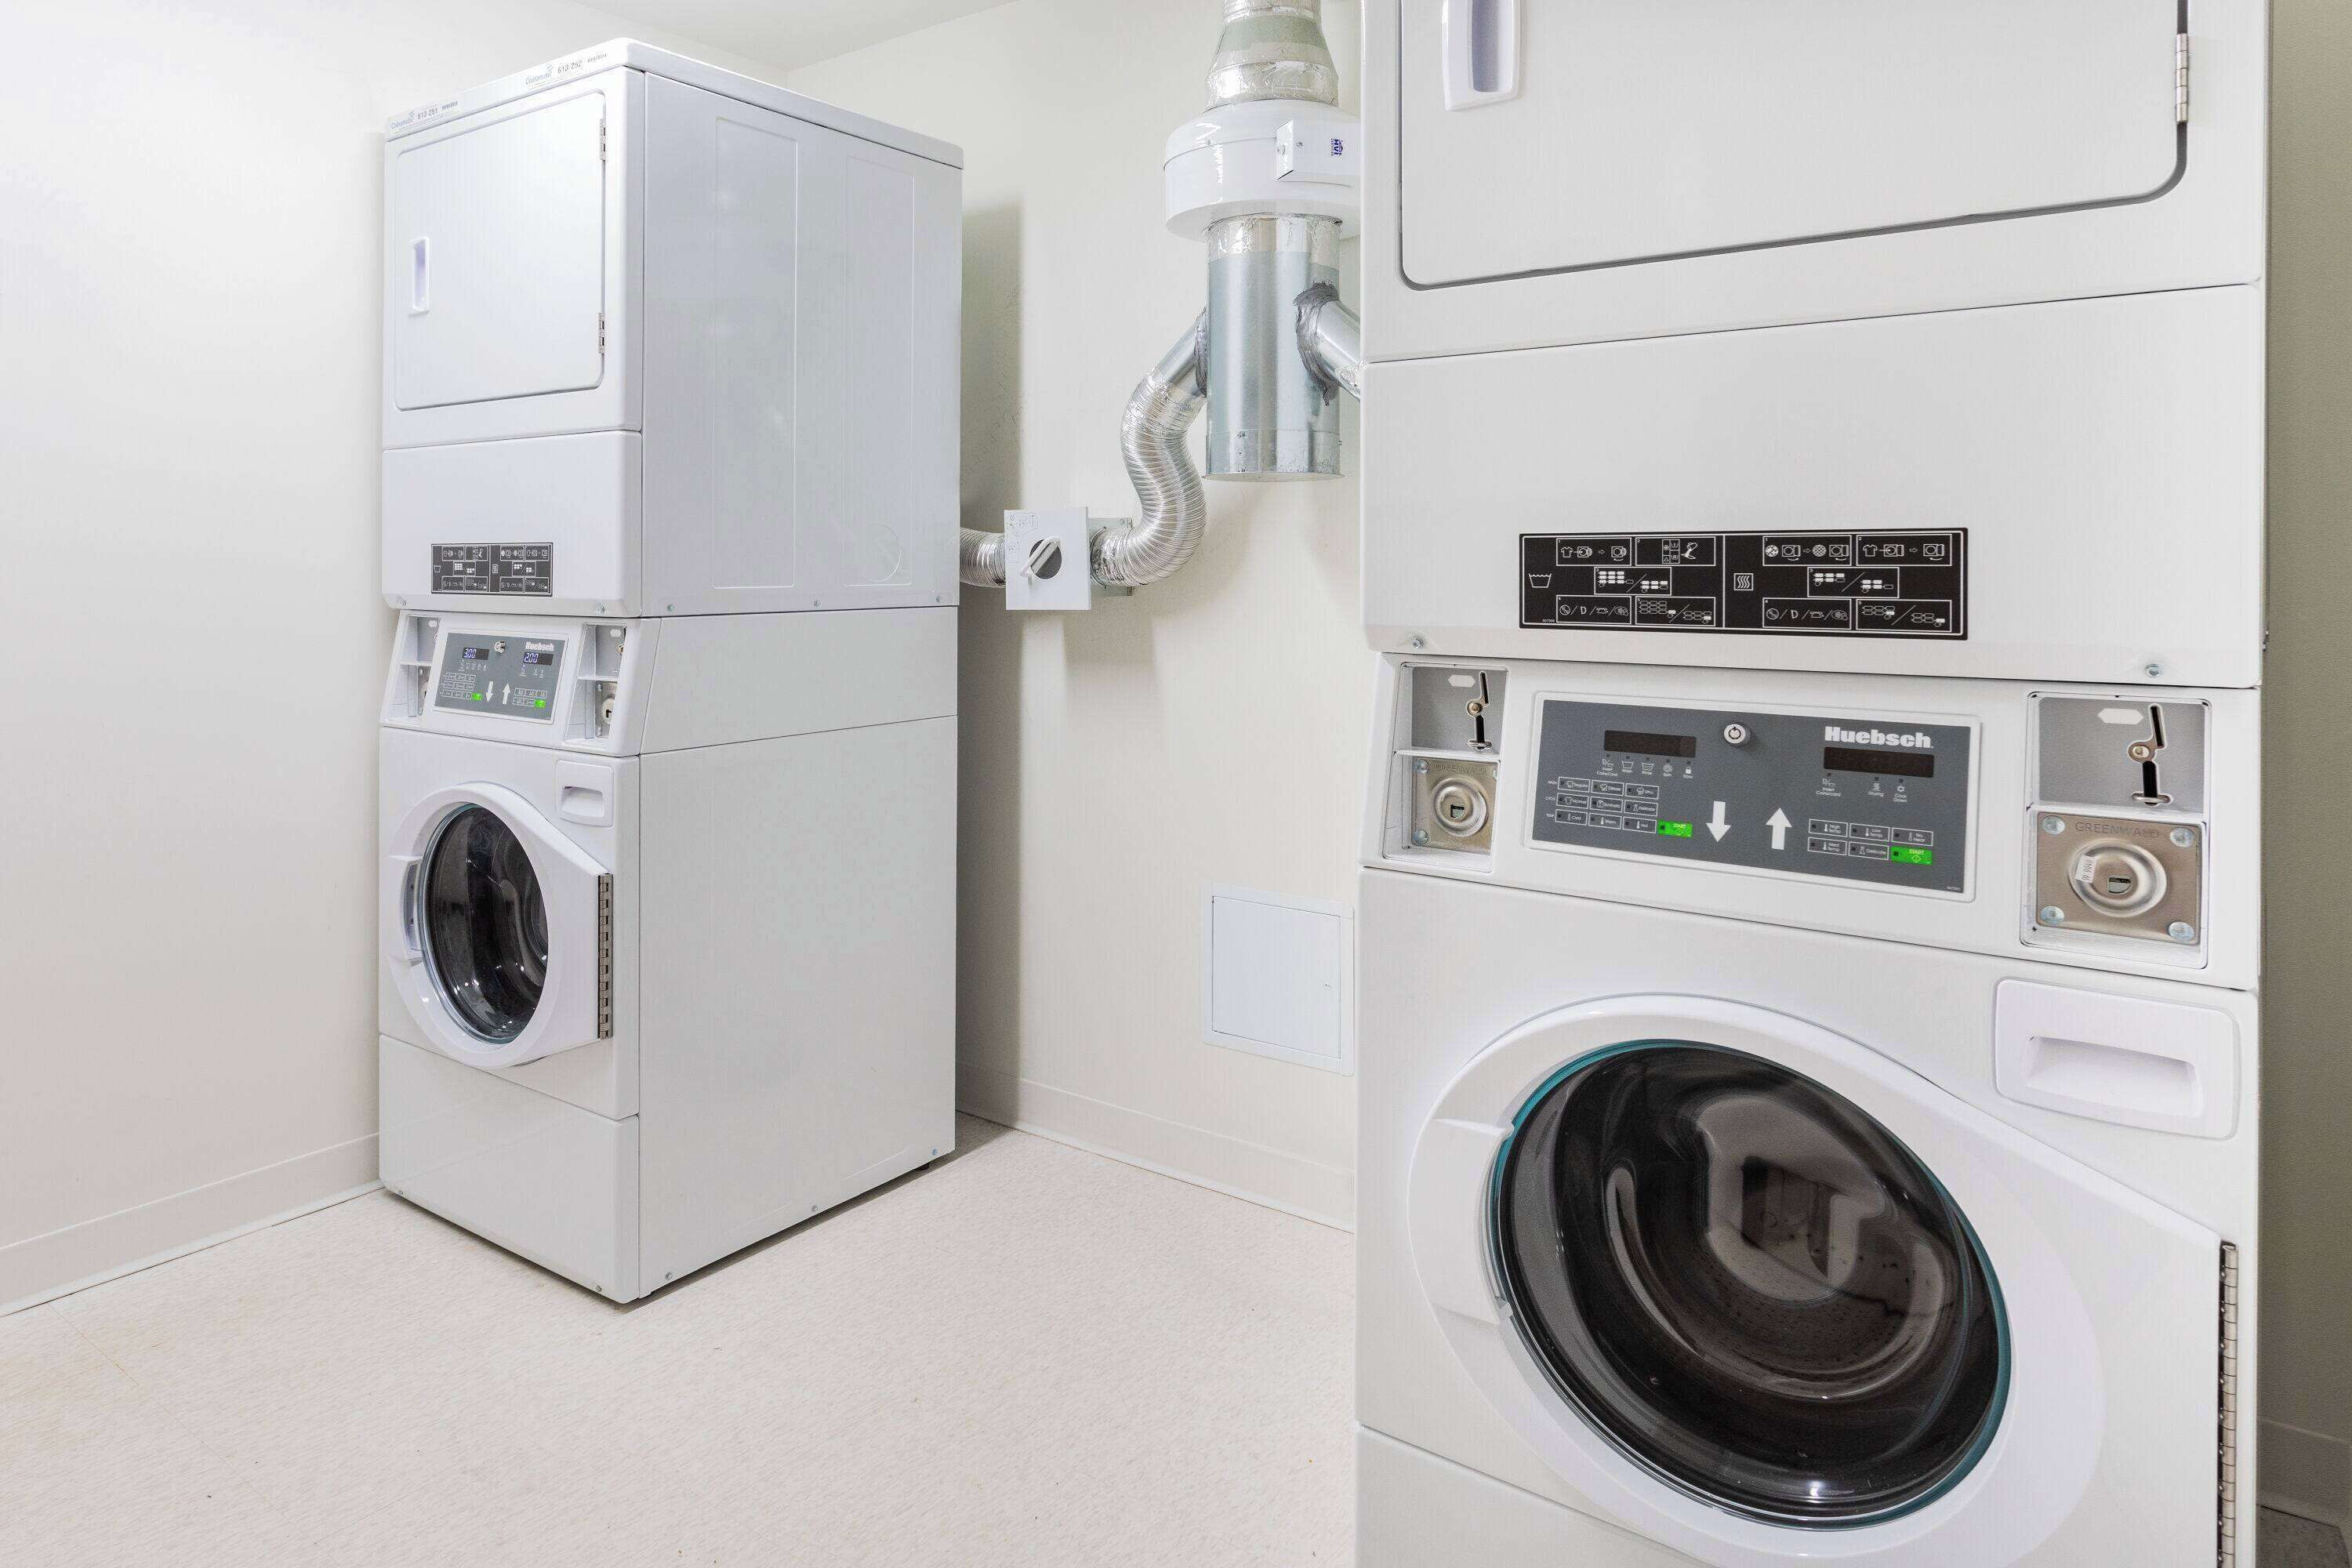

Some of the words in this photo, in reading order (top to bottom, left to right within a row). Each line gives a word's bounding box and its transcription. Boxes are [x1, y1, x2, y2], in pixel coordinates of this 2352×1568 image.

[557, 64, 569, 74] 613
[571, 60, 583, 70] 252
[417, 110, 427, 120] 613
[428, 107, 437, 116] 251
[525, 641, 554, 652] Huebsch
[1824, 725, 1932, 749] Huebsch
